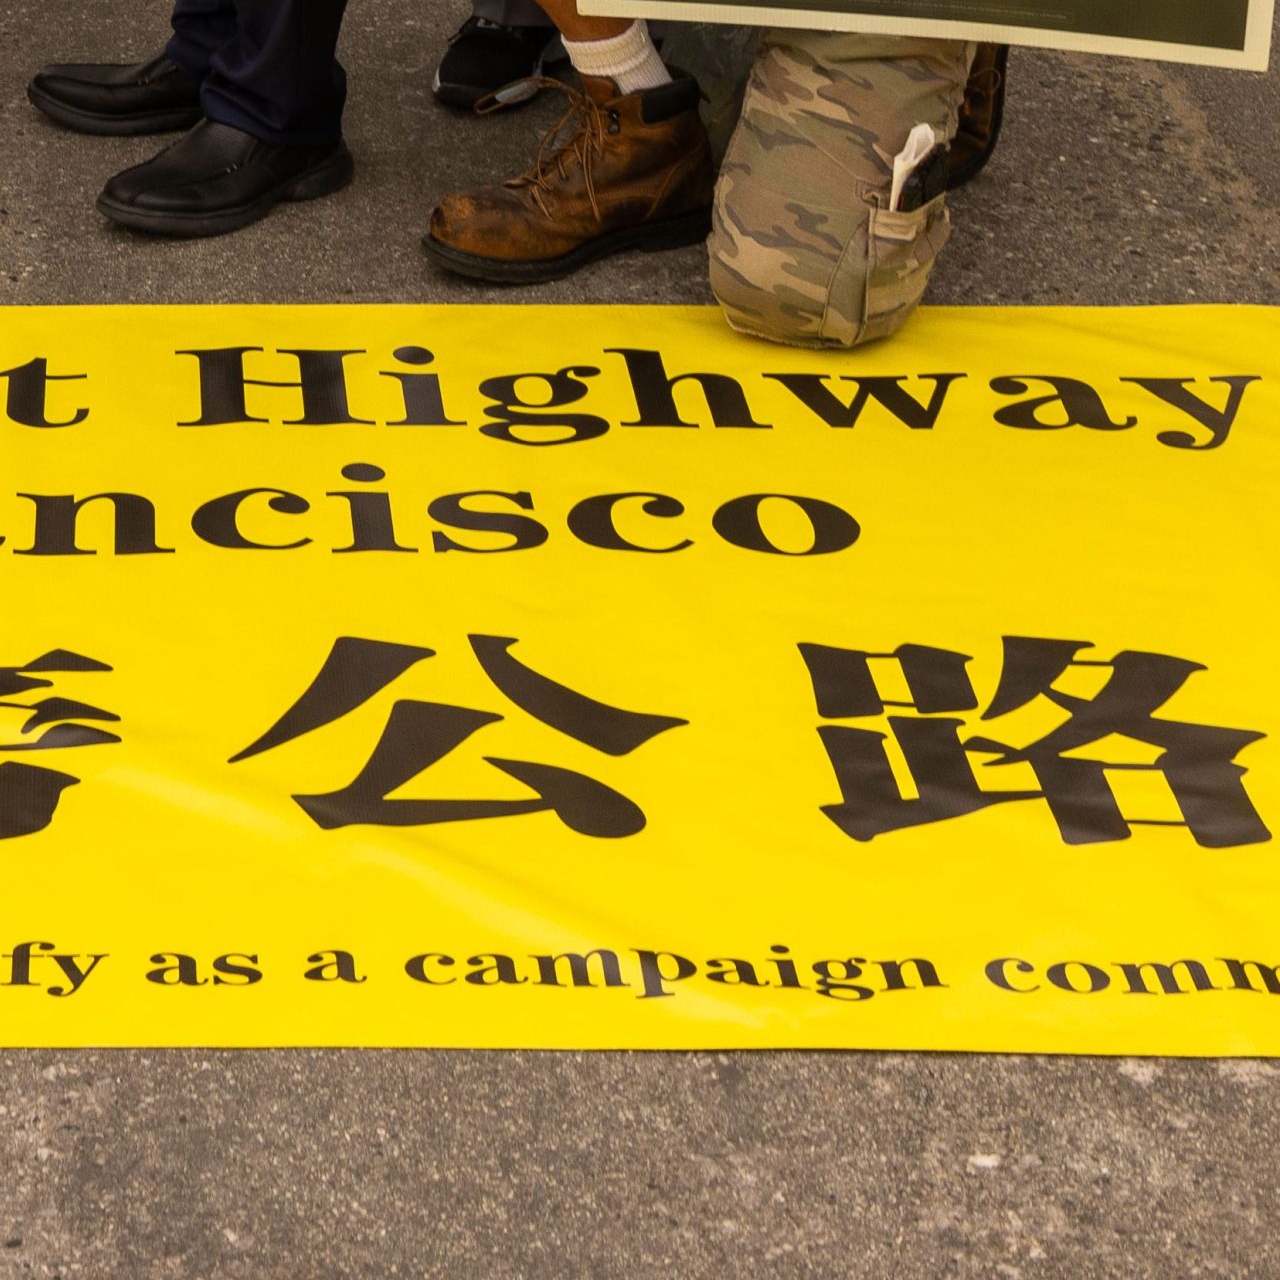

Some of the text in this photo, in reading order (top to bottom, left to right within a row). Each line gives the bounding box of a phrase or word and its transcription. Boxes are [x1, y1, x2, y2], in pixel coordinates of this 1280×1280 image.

[175, 346, 1261, 450] Highway
[146, 954, 262, 986] as
[304, 950, 367, 983] a
[405, 945, 944, 1000] campaign
